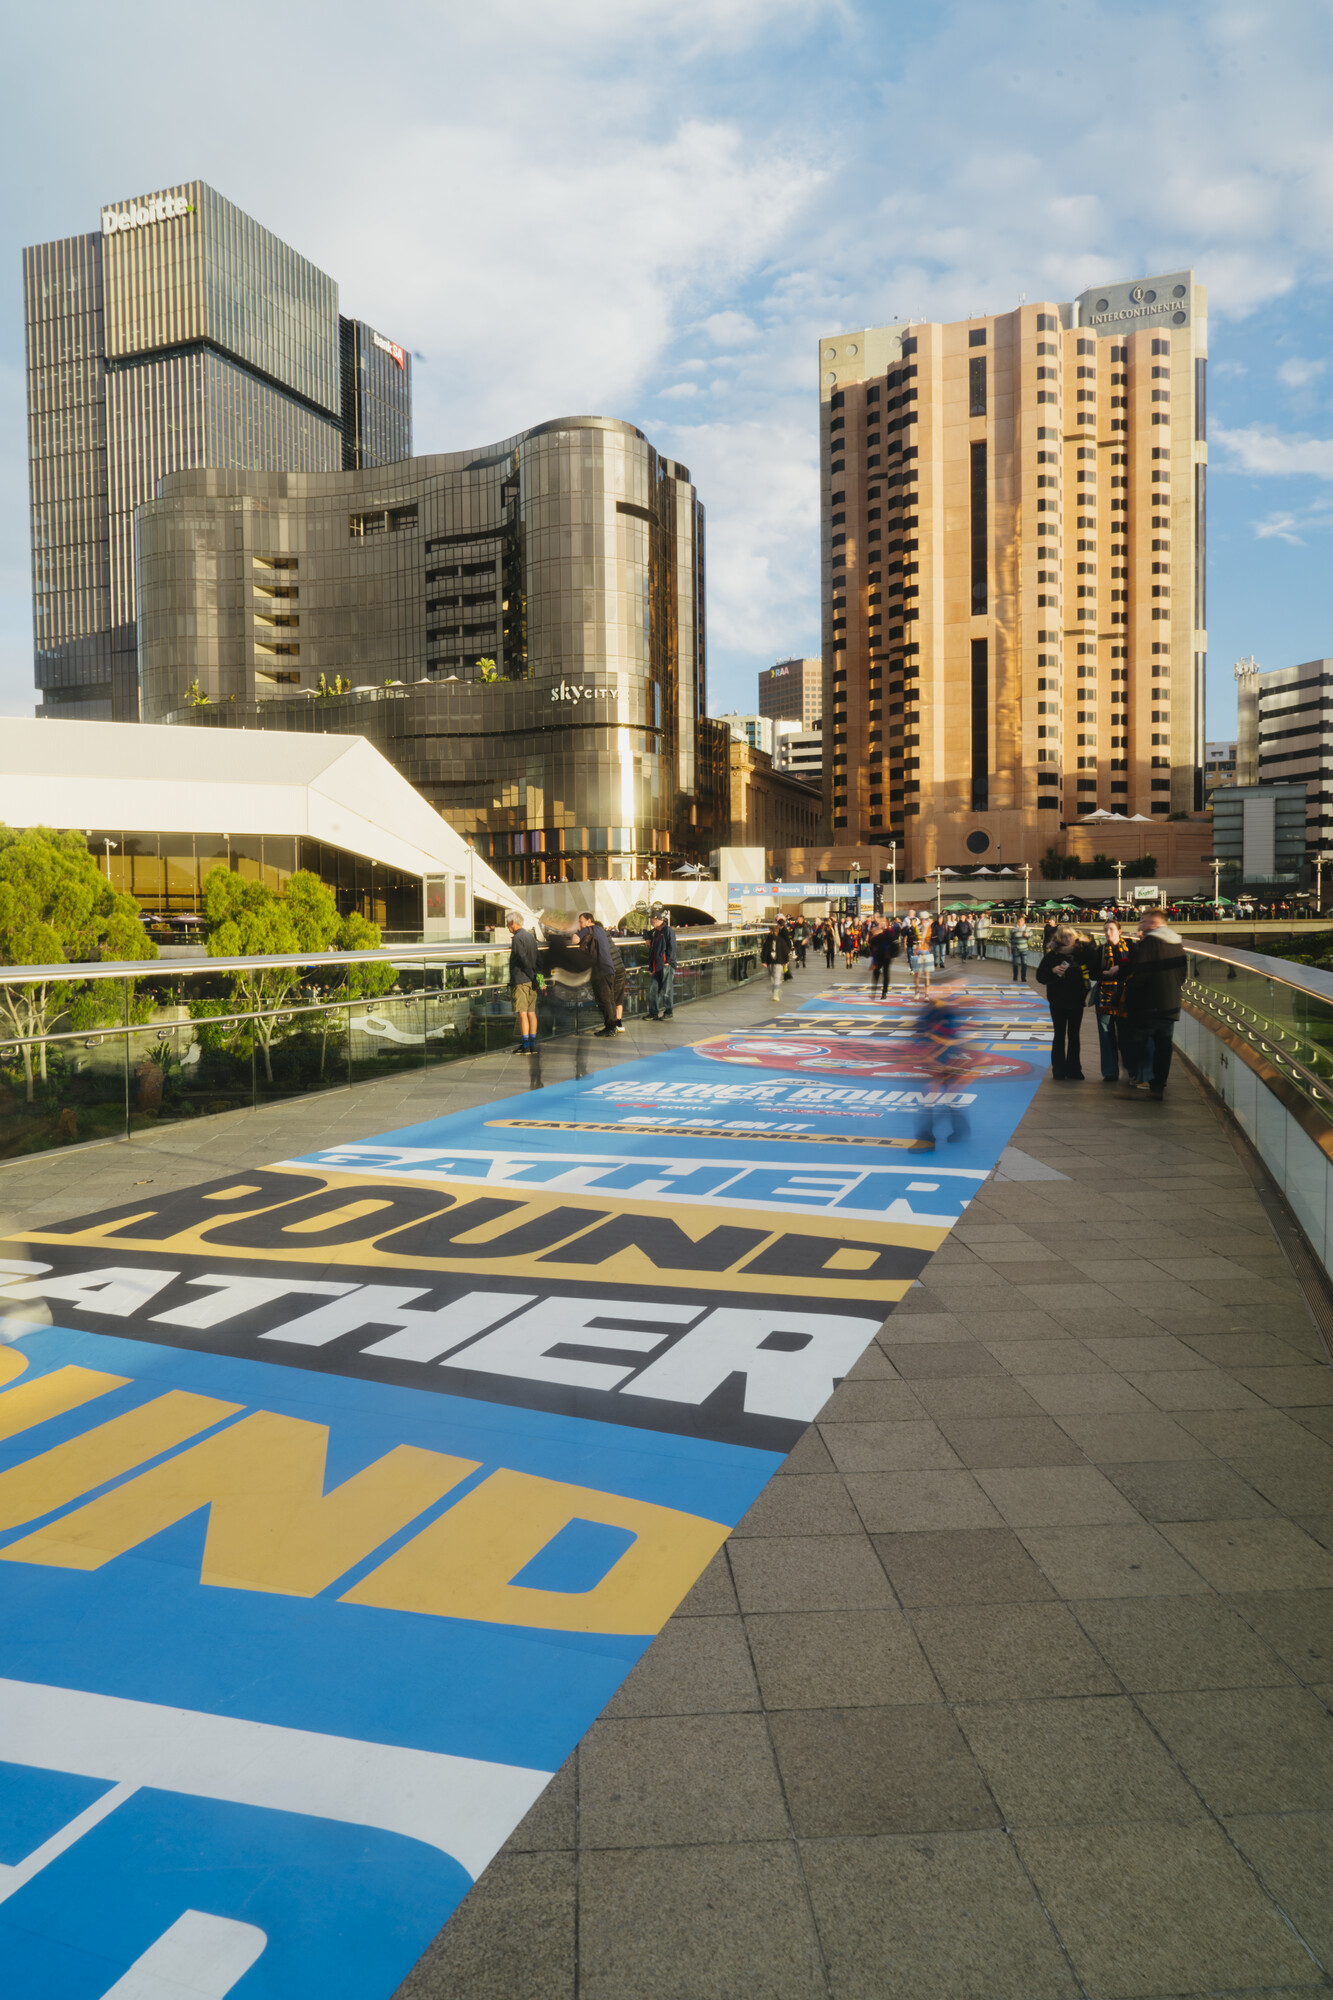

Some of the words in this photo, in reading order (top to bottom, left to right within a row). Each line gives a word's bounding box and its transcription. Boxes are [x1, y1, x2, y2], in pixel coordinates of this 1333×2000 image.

[775, 667, 789, 677] RAA
[804, 885, 822, 895] FOOTY
[823, 885, 850, 895] FESTIVAL
[592, 1081, 788, 1098] GATHER
[789, 1087, 978, 1105] ROUND
[508, 1120, 904, 1147] GATHERROUND.AFL
[618, 1116, 686, 1125] GET
[680, 1118, 726, 1126] IN
[722, 1120, 777, 1129] ON
[774, 1123, 816, 1131] IT
[289, 1152, 983, 1217] GATHER
[29, 1169, 938, 1281] ROUND
[0, 1345, 732, 1635] UND
